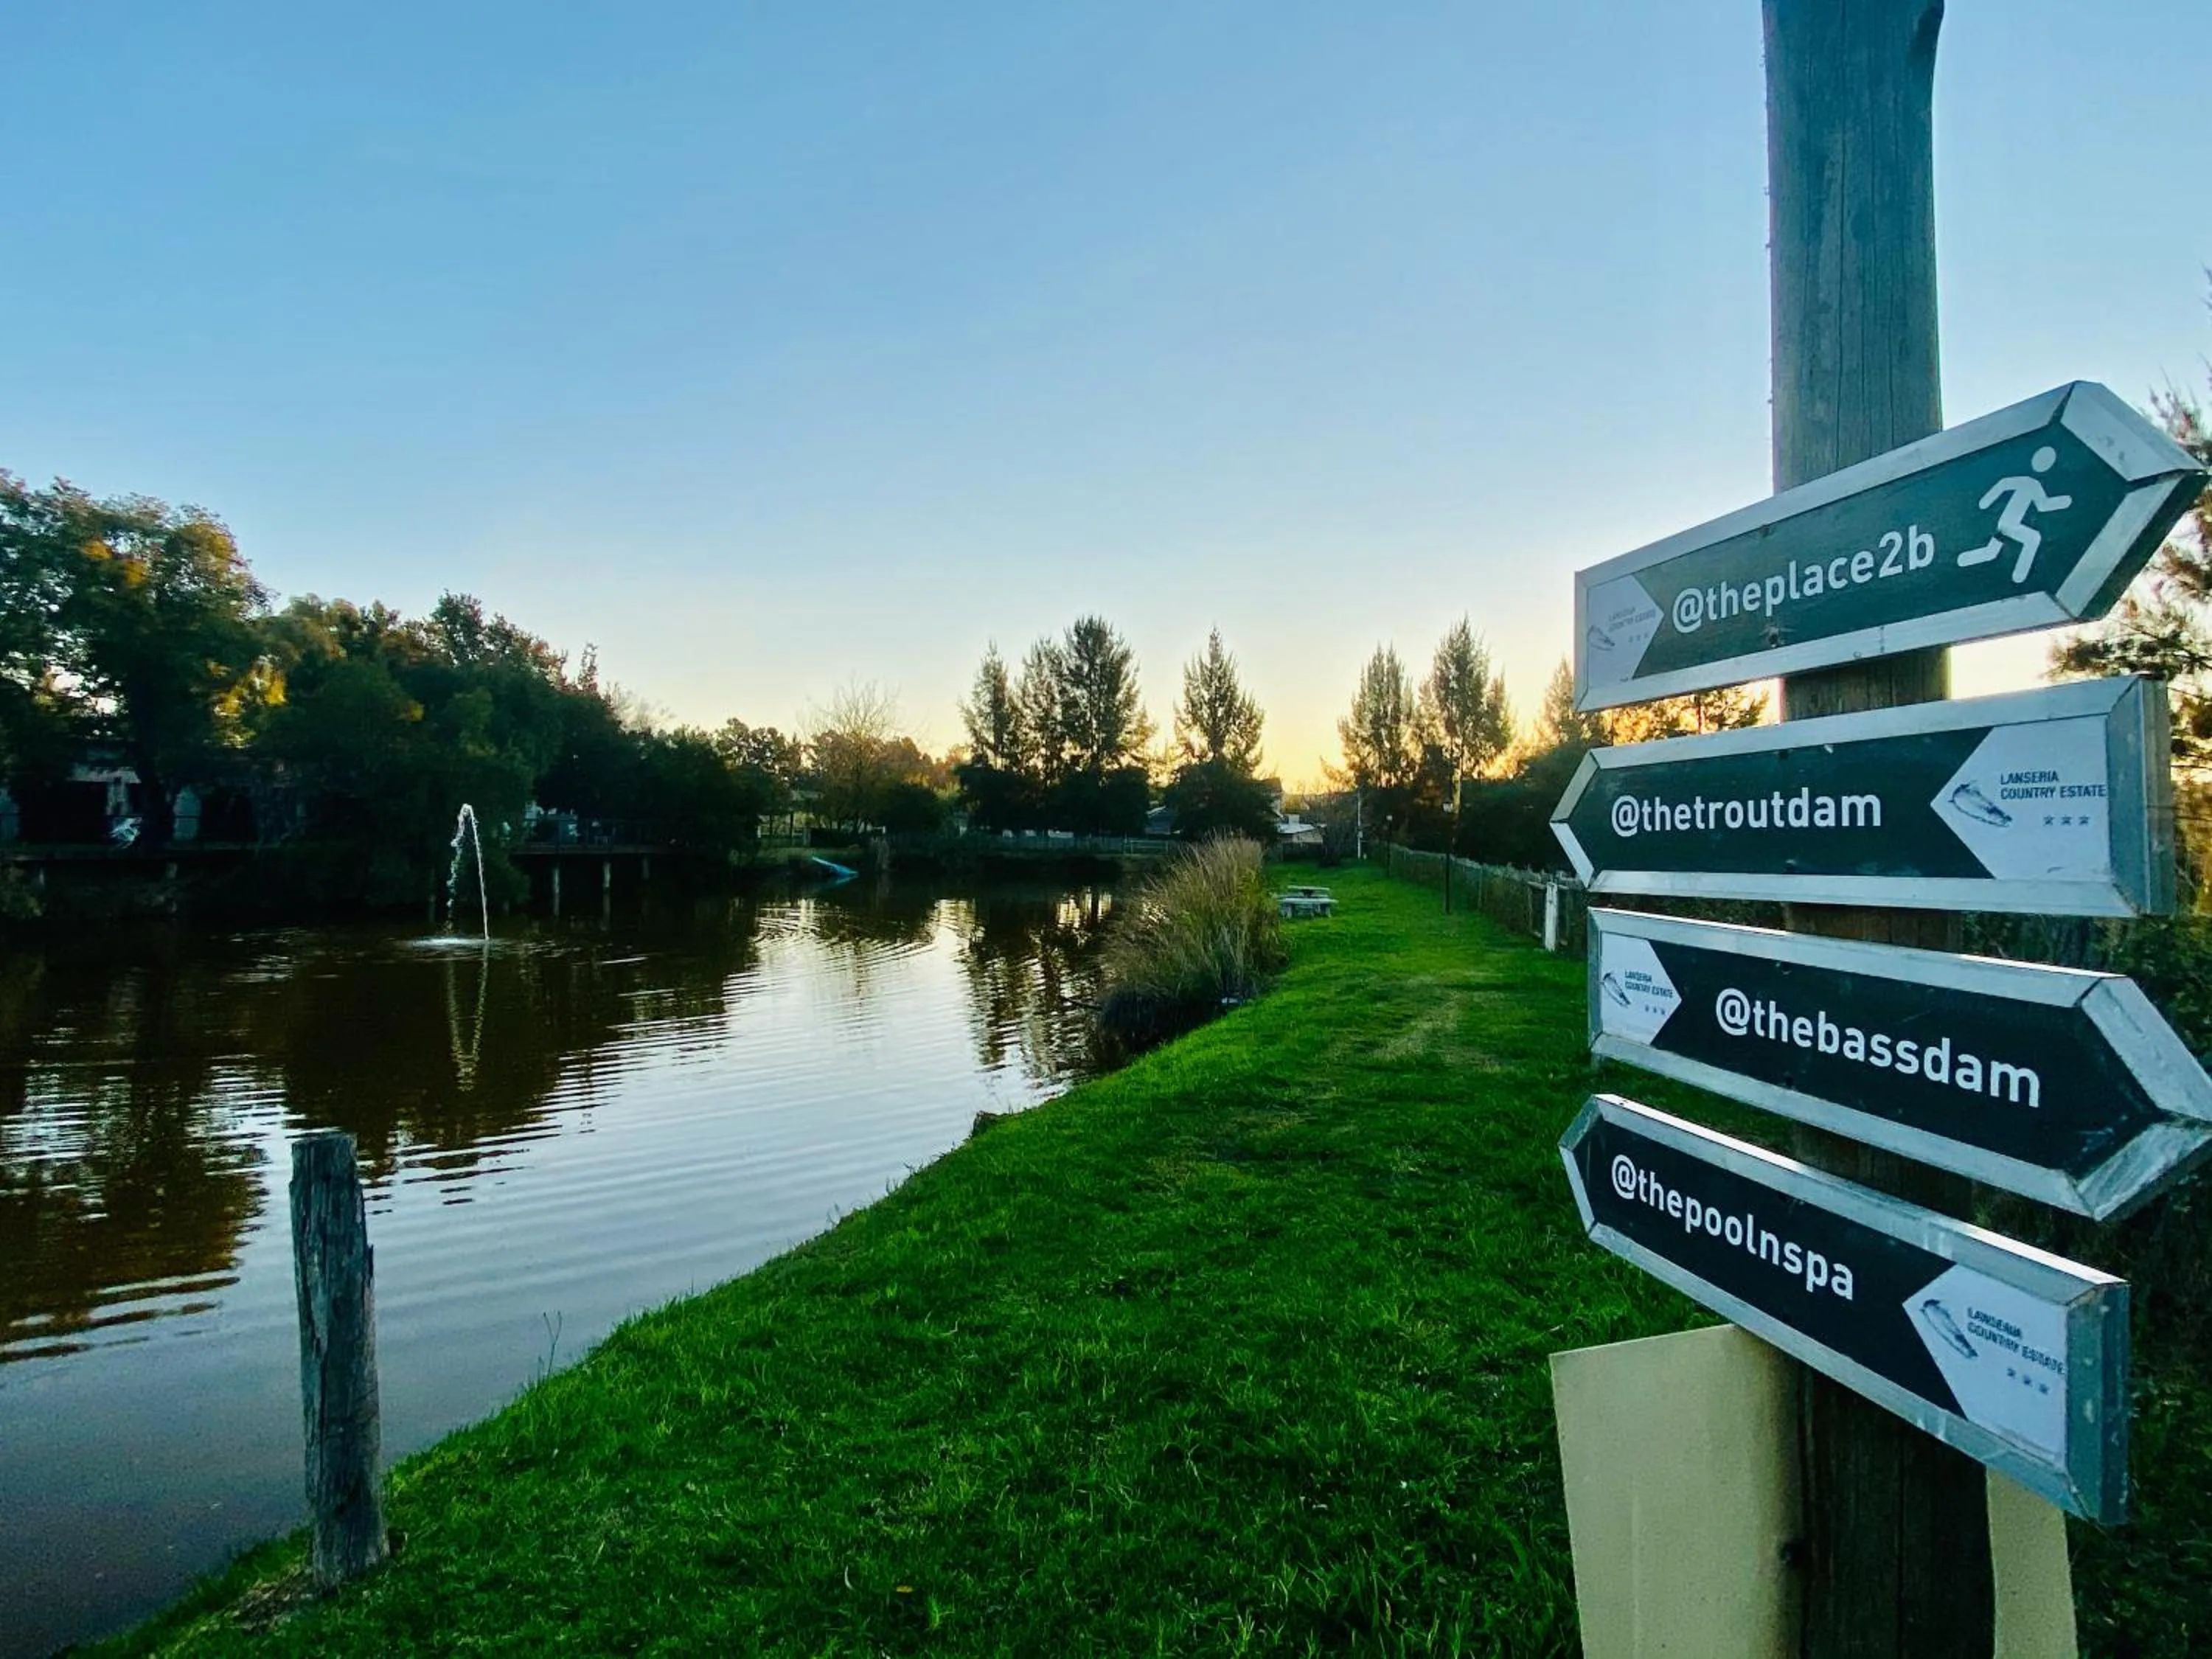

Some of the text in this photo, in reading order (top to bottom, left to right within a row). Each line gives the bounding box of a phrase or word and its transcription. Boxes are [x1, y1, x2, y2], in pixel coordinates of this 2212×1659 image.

[1672, 524, 1935, 634] @theplace2b
[2000, 771, 2059, 785] LANSERIA
[2000, 784, 2107, 800] COUNTRY ESTATE
[1610, 786, 1882, 838] @thetroutdam
[1715, 987, 2040, 1109] @thebassdam
[1610, 1153, 1854, 1301] @thepoolnspa
[1966, 1321, 2020, 1353] COUNTRY
